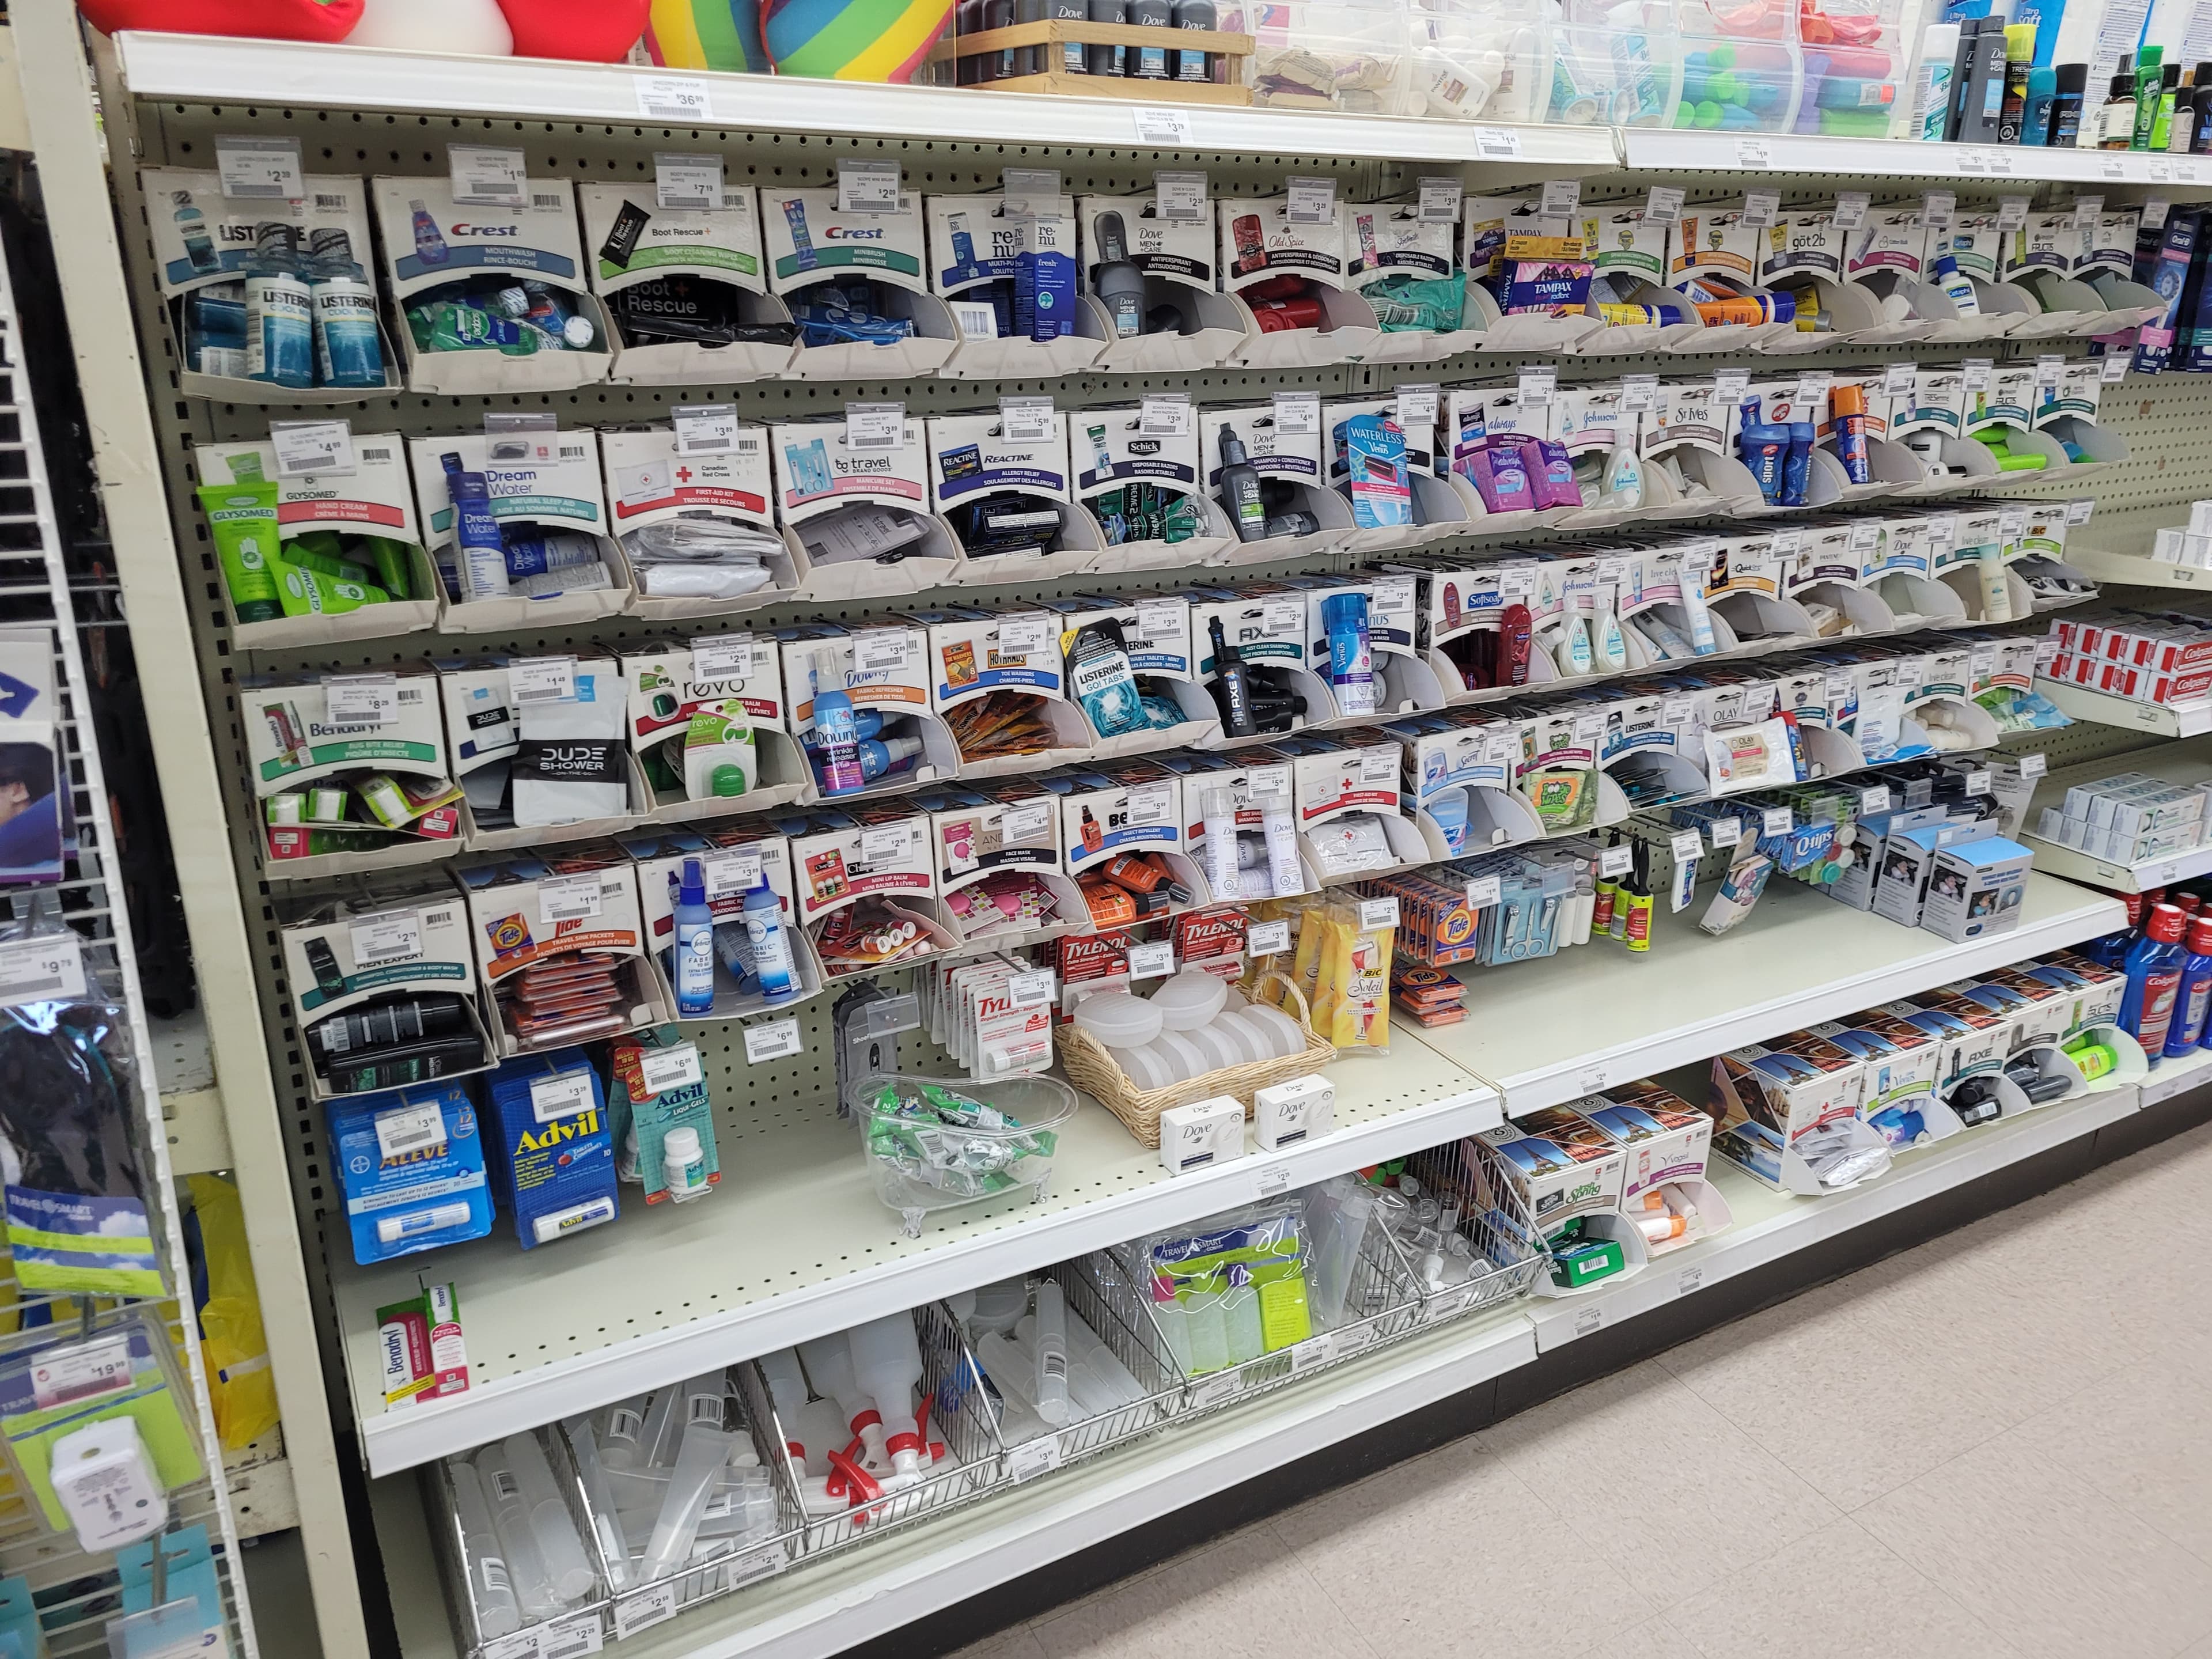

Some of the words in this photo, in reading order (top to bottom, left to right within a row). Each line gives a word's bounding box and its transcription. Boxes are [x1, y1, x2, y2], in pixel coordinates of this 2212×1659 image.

[1058, 5, 1082, 19] Dove
[1142, 14, 1166, 27] Dove
[1182, 19, 1206, 31] Dove
[451, 224, 519, 237] Crest
[652, 229, 672, 237] Boot
[825, 226, 887, 240] Crest
[1139, 228, 1164, 239] Dove
[1268, 234, 1285, 248] Old
[1284, 234, 1305, 249] Spice
[1792, 233, 1826, 251] göt2b
[485, 247, 536, 258] MOUTHWASH
[854, 248, 886, 258] MINIBRUSH
[1271, 252, 1308, 261] ANTIPERSPIRANT
[483, 257, 538, 268] RINCE-BOUCHE
[852, 257, 887, 267] MINIBROSSE
[1150, 255, 1192, 267] ANTIPERSPIRANT
[1147, 262, 1192, 274] ANTISUDORIFIQUE
[1501, 272, 1513, 313] TAMPAX
[1533, 281, 1573, 294] TAMPAX
[1948, 287, 1972, 298] Cetaphil
[320, 296, 377, 310] LISTERINE
[627, 296, 698, 314] Rescue
[1119, 297, 1135, 306] Dove
[328, 308, 353, 317] COOL
[1487, 416, 1517, 431] always
[1583, 411, 1618, 429] Johnson's
[1253, 433, 1276, 444] Dove
[1350, 426, 1402, 446] WATERLESS
[1130, 442, 1158, 453] Schick
[1369, 443, 1389, 455] Venus
[1548, 448, 1568, 459] always
[852, 456, 892, 469] travel
[943, 451, 978, 467] REACTINE
[984, 454, 1035, 464] REACTINE
[1497, 455, 1521, 467] always
[487, 470, 537, 482] Dream
[983, 478, 1021, 486] SOULAGEMENT
[1031, 479, 1057, 488] ALLERGIES
[1242, 480, 1259, 490] Dove
[286, 490, 336, 500] GLYSOMED
[488, 484, 533, 496] Water
[315, 502, 339, 511] HAND
[340, 503, 368, 512] CREAM
[719, 499, 746, 508] SECOURS
[213, 508, 275, 521] GLYSOMED
[464, 513, 494, 524] Dream
[466, 524, 496, 534] Water
[1893, 539, 1912, 551] Dove
[1469, 593, 1503, 608] Softsoap
[1336, 641, 1346, 669] Venus
[1079, 661, 1126, 685] LISTERINE
[1086, 681, 1103, 691] GO!
[1103, 673, 1125, 685] TABS
[1230, 680, 1241, 709] AXE
[744, 699, 761, 707] BALM
[1713, 707, 1740, 722] OLAY
[1625, 719, 1656, 733] LISTERINE
[817, 729, 858, 745] Downy
[1738, 735, 1755, 745] OLAY
[540, 747, 607, 762] DUDE
[827, 747, 854, 755] wrinkle
[827, 752, 858, 763] releaser
[540, 761, 605, 771] SHOWER
[1274, 824, 1293, 833] Dove
[1795, 830, 1834, 857] Q-tips
[1186, 917, 1246, 942] TYLENOL
[1446, 918, 1469, 940] Tide
[499, 929, 521, 945] Tide
[552, 937, 574, 946] TRAVEL
[572, 941, 597, 949] VOYAGE
[1066, 935, 1127, 960] TYLENOL
[1363, 968, 1383, 978] BIC
[1411, 971, 1437, 985] Tide
[1347, 979, 1384, 998] Soleil
[1968, 1046, 1993, 1063] AXE
[655, 1083, 703, 1109] Advil
[673, 1098, 706, 1116] LIQUI-GELS
[1278, 1100, 1306, 1119] Dove
[513, 1109, 600, 1156] Advil
[1183, 1122, 1213, 1139] Dove
[603, 1149, 611, 1157] 10
[1565, 1184, 1601, 1205] Spring
[1164, 1245, 1192, 1257] TRAVEL
[1196, 1238, 1222, 1251] SMART
[434, 1286, 448, 1308] Benadryl
[381, 1328, 406, 1375] Benadryl
